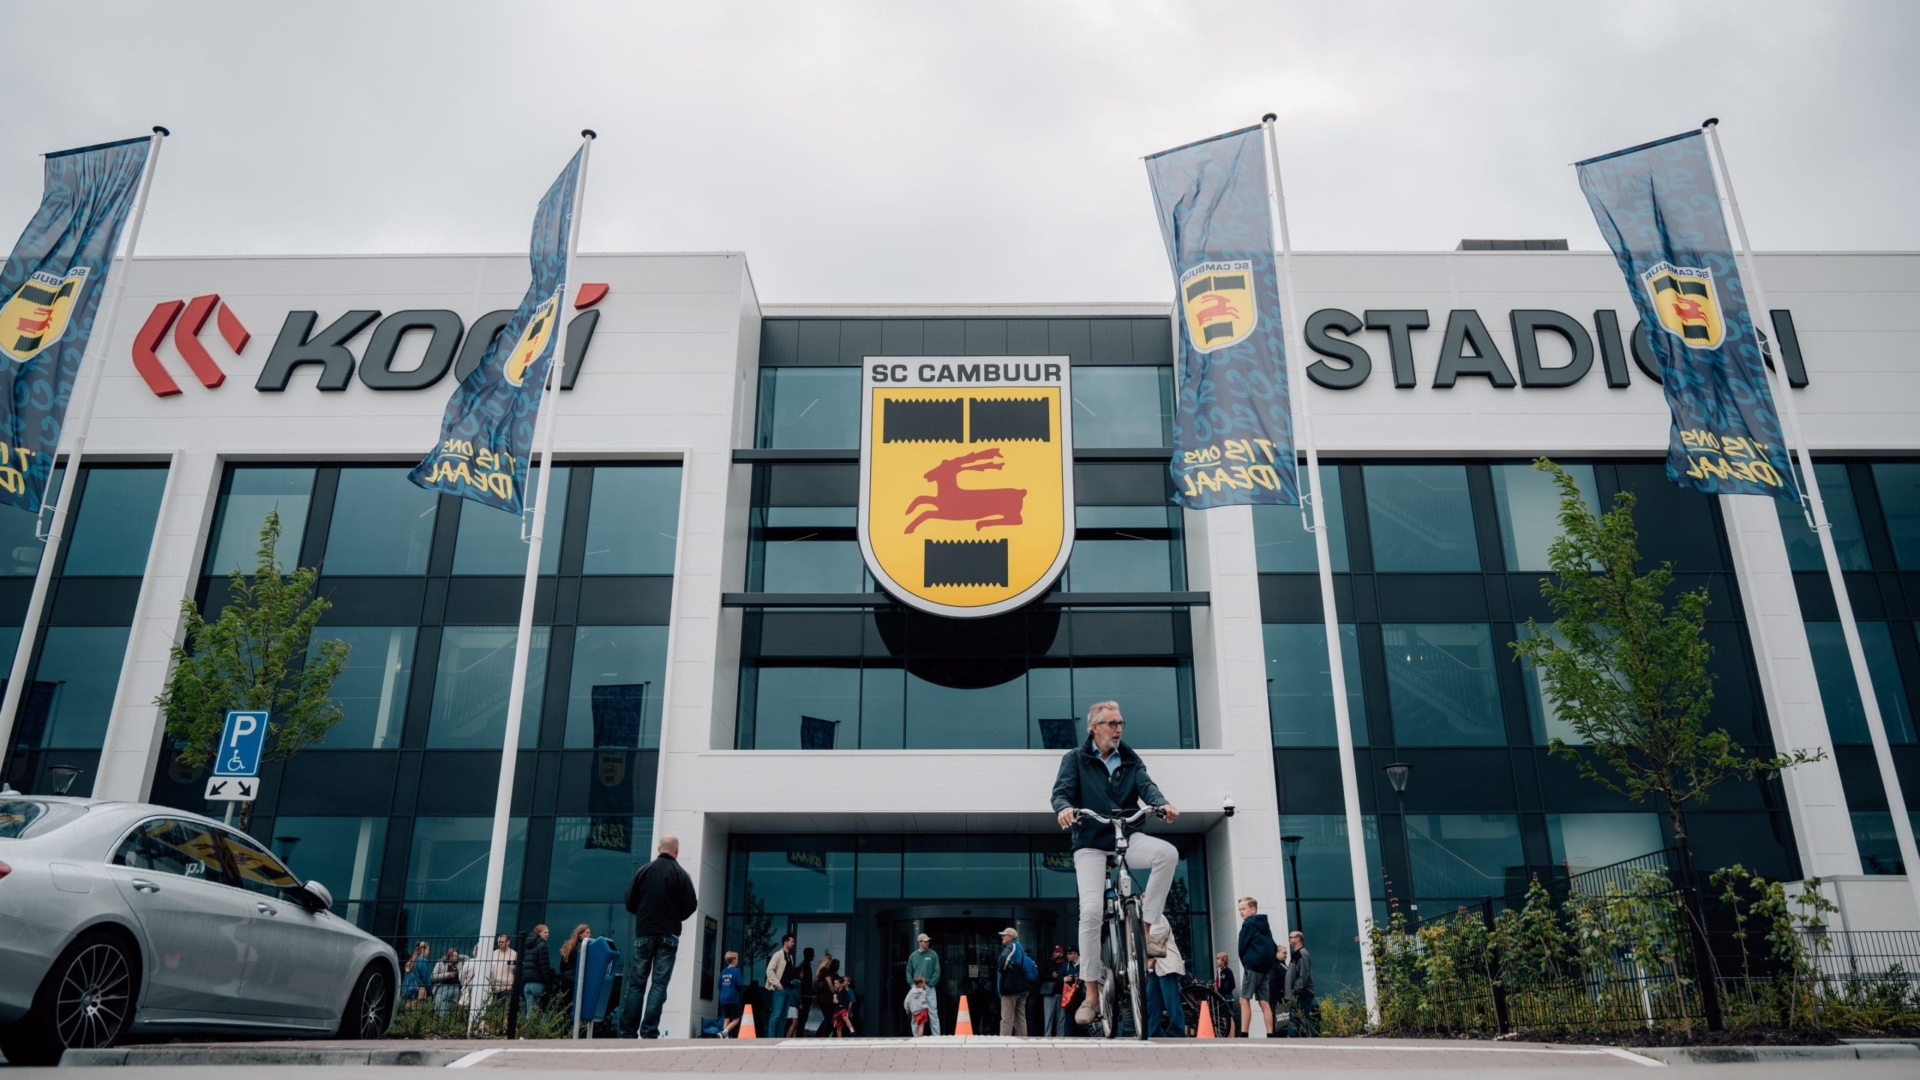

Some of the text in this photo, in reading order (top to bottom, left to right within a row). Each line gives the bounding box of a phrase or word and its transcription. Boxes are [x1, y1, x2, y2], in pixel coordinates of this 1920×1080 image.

[871, 363, 1062, 383] SC CAMBUUR
[230, 715, 257, 748] P
